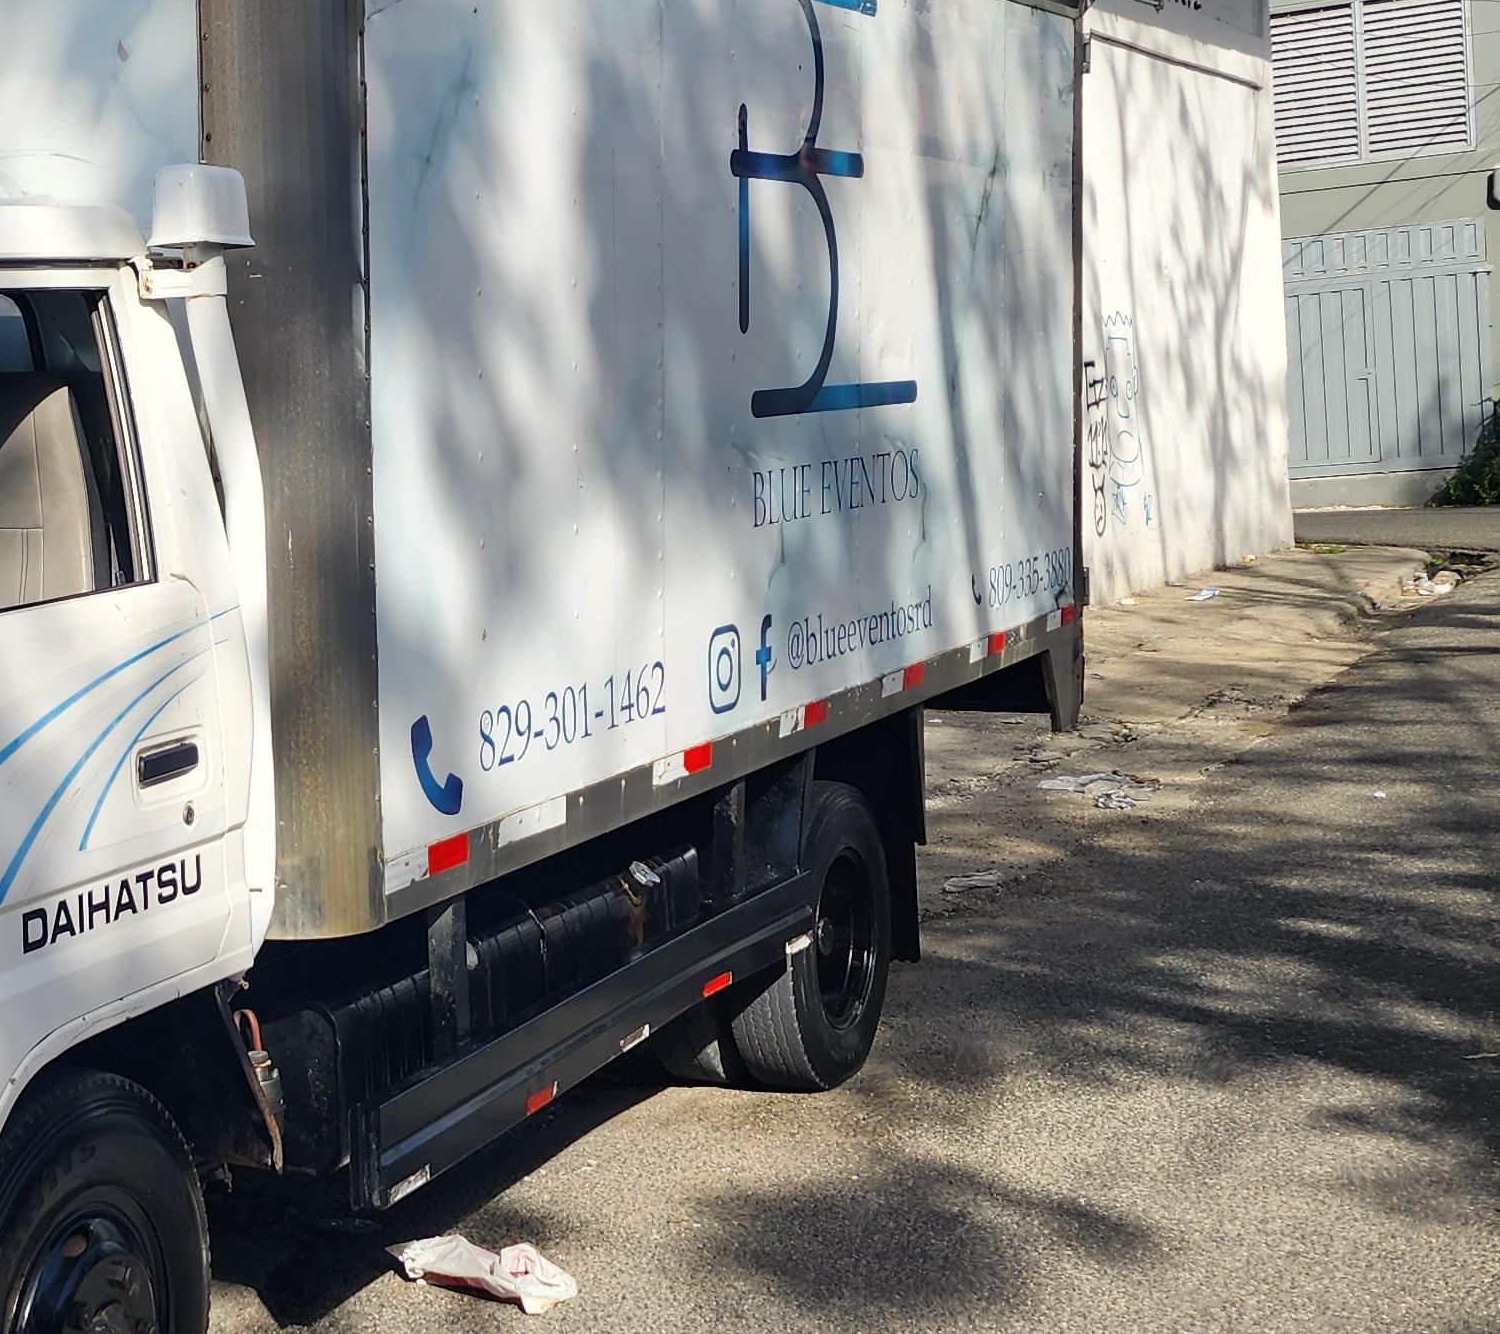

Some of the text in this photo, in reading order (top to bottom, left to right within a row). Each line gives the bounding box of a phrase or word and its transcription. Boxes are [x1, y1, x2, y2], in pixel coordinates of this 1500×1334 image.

[752, 448, 920, 528] BLUE EVENTOS
[989, 547, 1071, 608] 809-335-3880
[788, 584, 933, 670] @blueeventosrd
[480, 660, 666, 771] 829-301-1462
[22, 854, 202, 954] DAIHATSU
